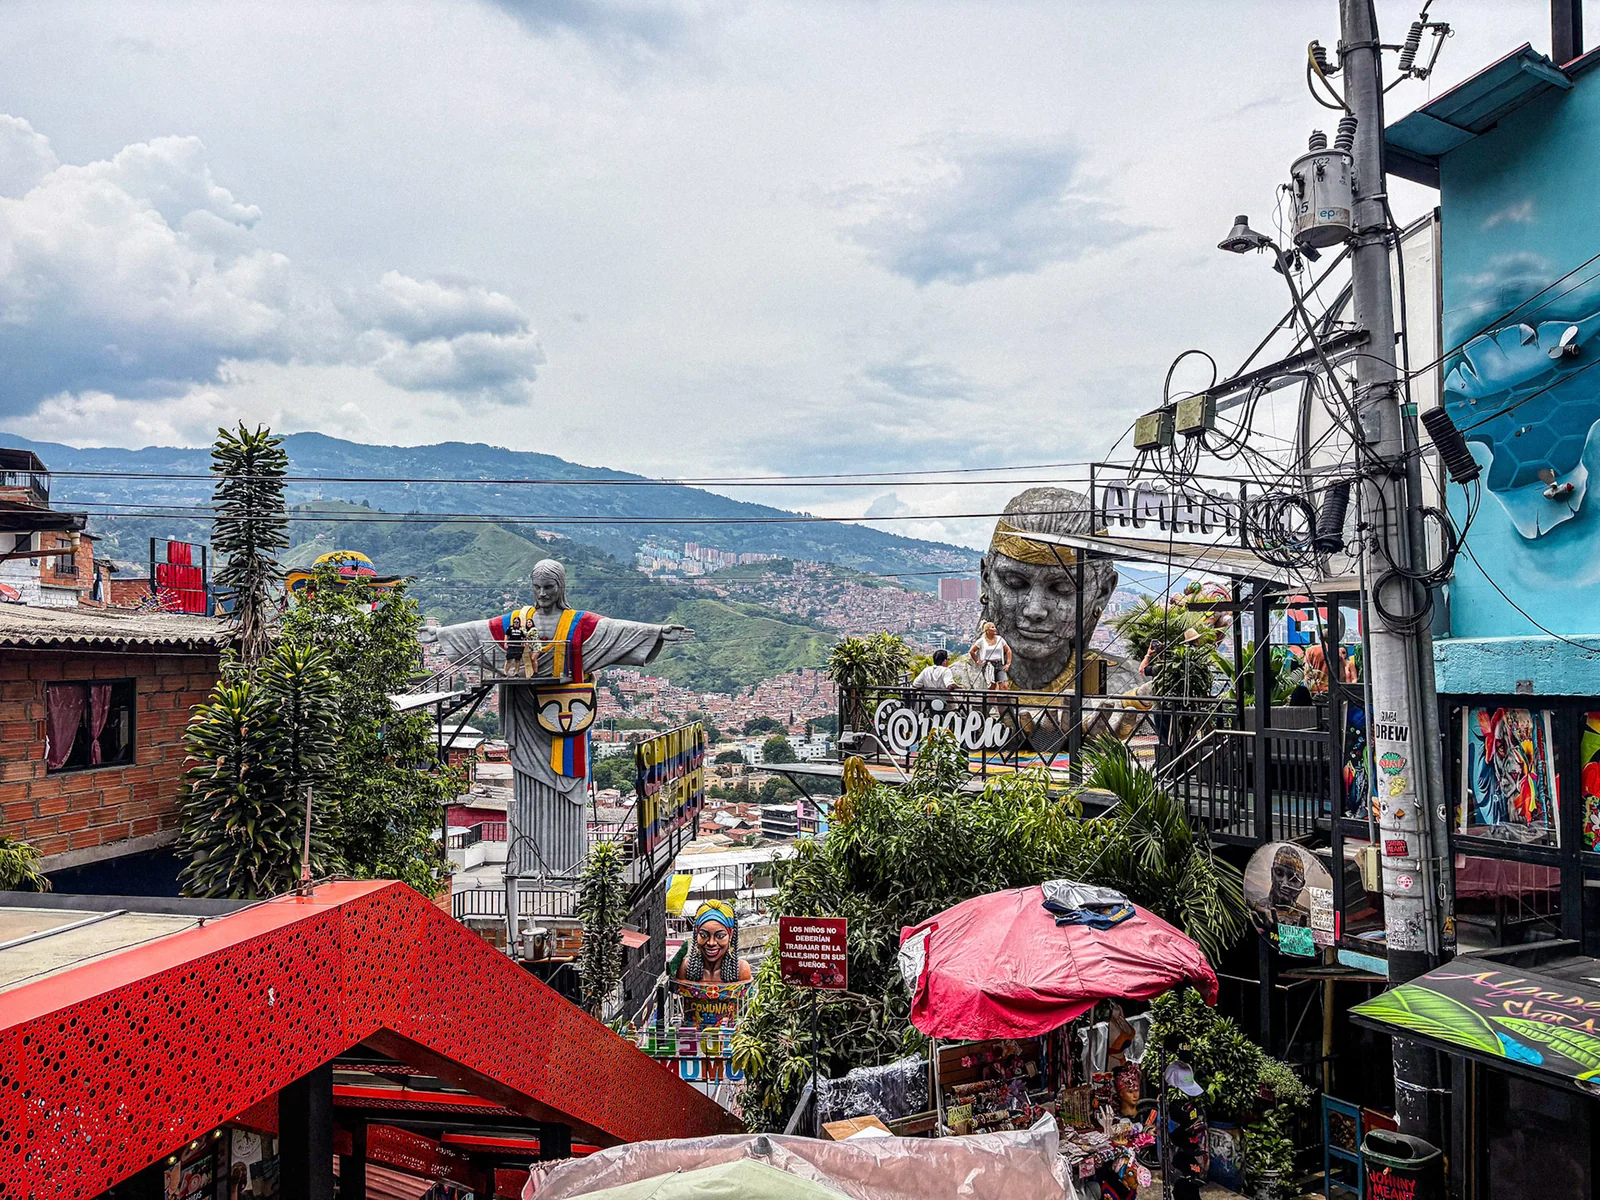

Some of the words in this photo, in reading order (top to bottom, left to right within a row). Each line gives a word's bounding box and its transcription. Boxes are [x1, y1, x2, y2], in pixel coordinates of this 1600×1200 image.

[1376, 723, 1409, 742] DREW
[803, 925, 825, 934] NIÑOS
[795, 934, 831, 943] DEBERÍAN
[784, 943, 820, 951] TRABAJAR
[798, 960, 828, 969] SUEÑOS.
[690, 1002, 728, 1015] COMUNA
[1369, 1169, 1416, 1193] JOHNNY
[1373, 1183, 1415, 1200] MEANT
